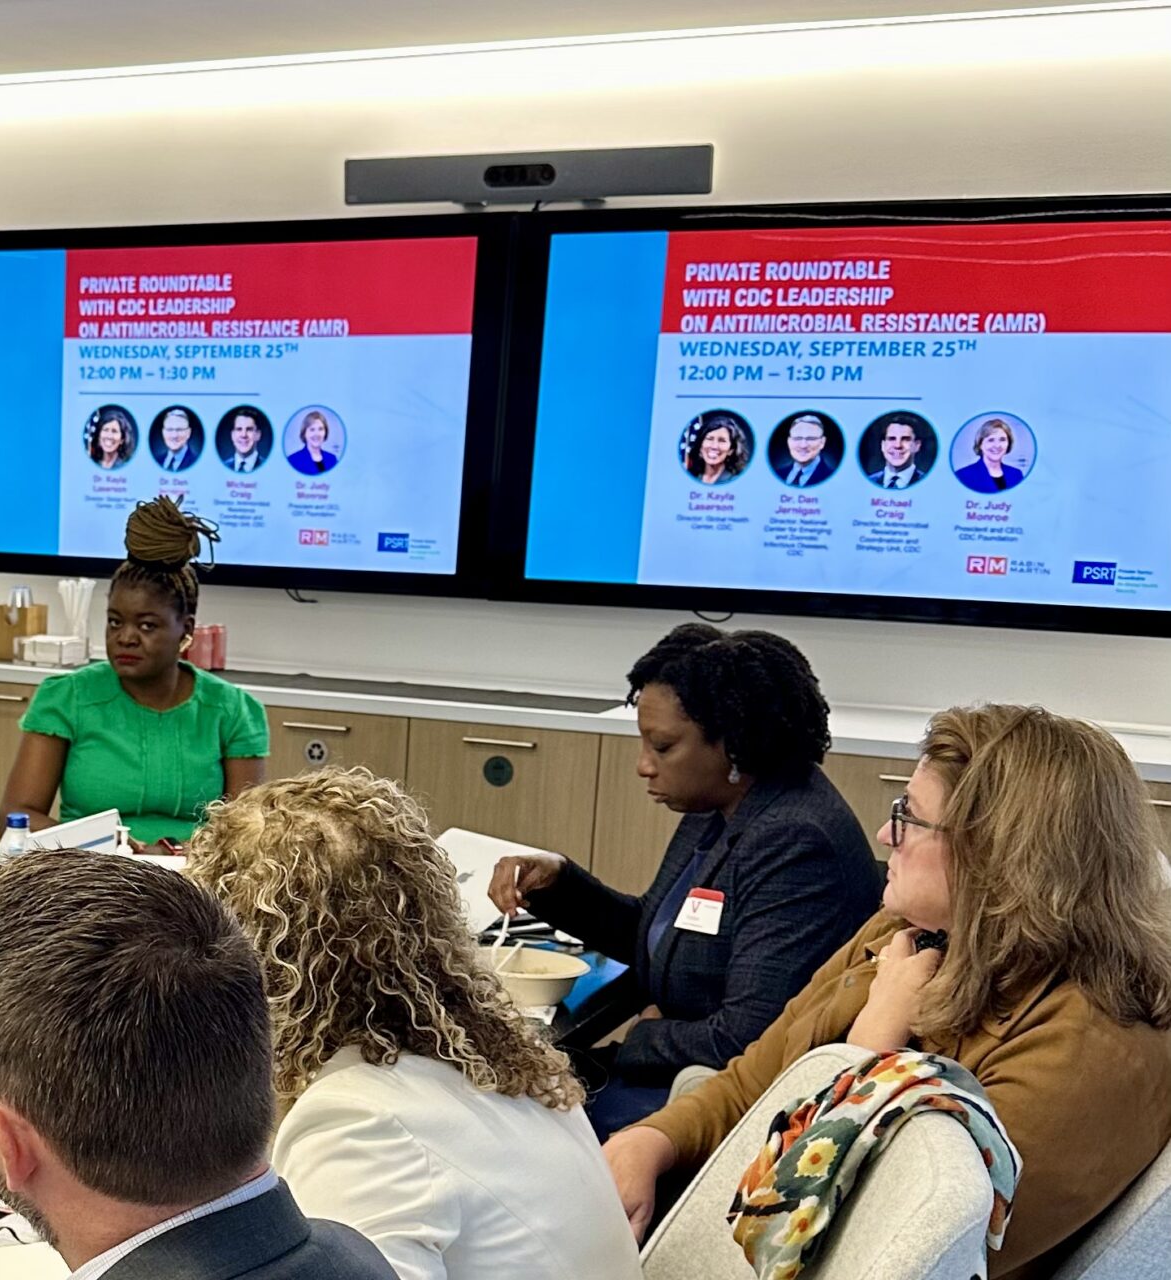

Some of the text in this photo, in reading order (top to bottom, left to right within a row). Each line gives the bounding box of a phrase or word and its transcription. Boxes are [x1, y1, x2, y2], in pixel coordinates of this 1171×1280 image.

[685, 261, 890, 282] PRIVATE ROUNDTABLE
[80, 274, 232, 293] PRIVATE ROUNDTABLE
[683, 287, 893, 307] WITH CDC LEADERSHIP
[79, 297, 235, 316] WITH CDC LEADERSHIP
[79, 319, 349, 338] ON ANTIMICROBIAL RESISTANCE (AMR)
[681, 313, 1046, 333] ON ANTIMICROBIAL RESISTANCE (AMR)
[79, 342, 299, 360] WEDNESDAY, SEPTEMBER 25TH
[680, 338, 977, 359] WEDNESDAY, SEPTEMBER 25TH
[79, 366, 116, 380] 12:00
[120, 366, 142, 380] PM
[159, 366, 188, 380] 1:30
[193, 366, 215, 380] PM
[678, 365, 727, 380] 12:00
[733, 365, 763, 380] PM
[787, 365, 826, 380] 1:30
[831, 365, 863, 380] PM
[707, 492, 735, 502] Kayla
[780, 494, 818, 504] Dr. Dan
[871, 498, 912, 507] Michael
[775, 506, 821, 517] Jernigan
[966, 500, 1011, 512] Dr. Judy
[875, 508, 905, 519] Craig
[966, 512, 1009, 522] Monroe
[1082, 566, 1116, 580] PSRT
